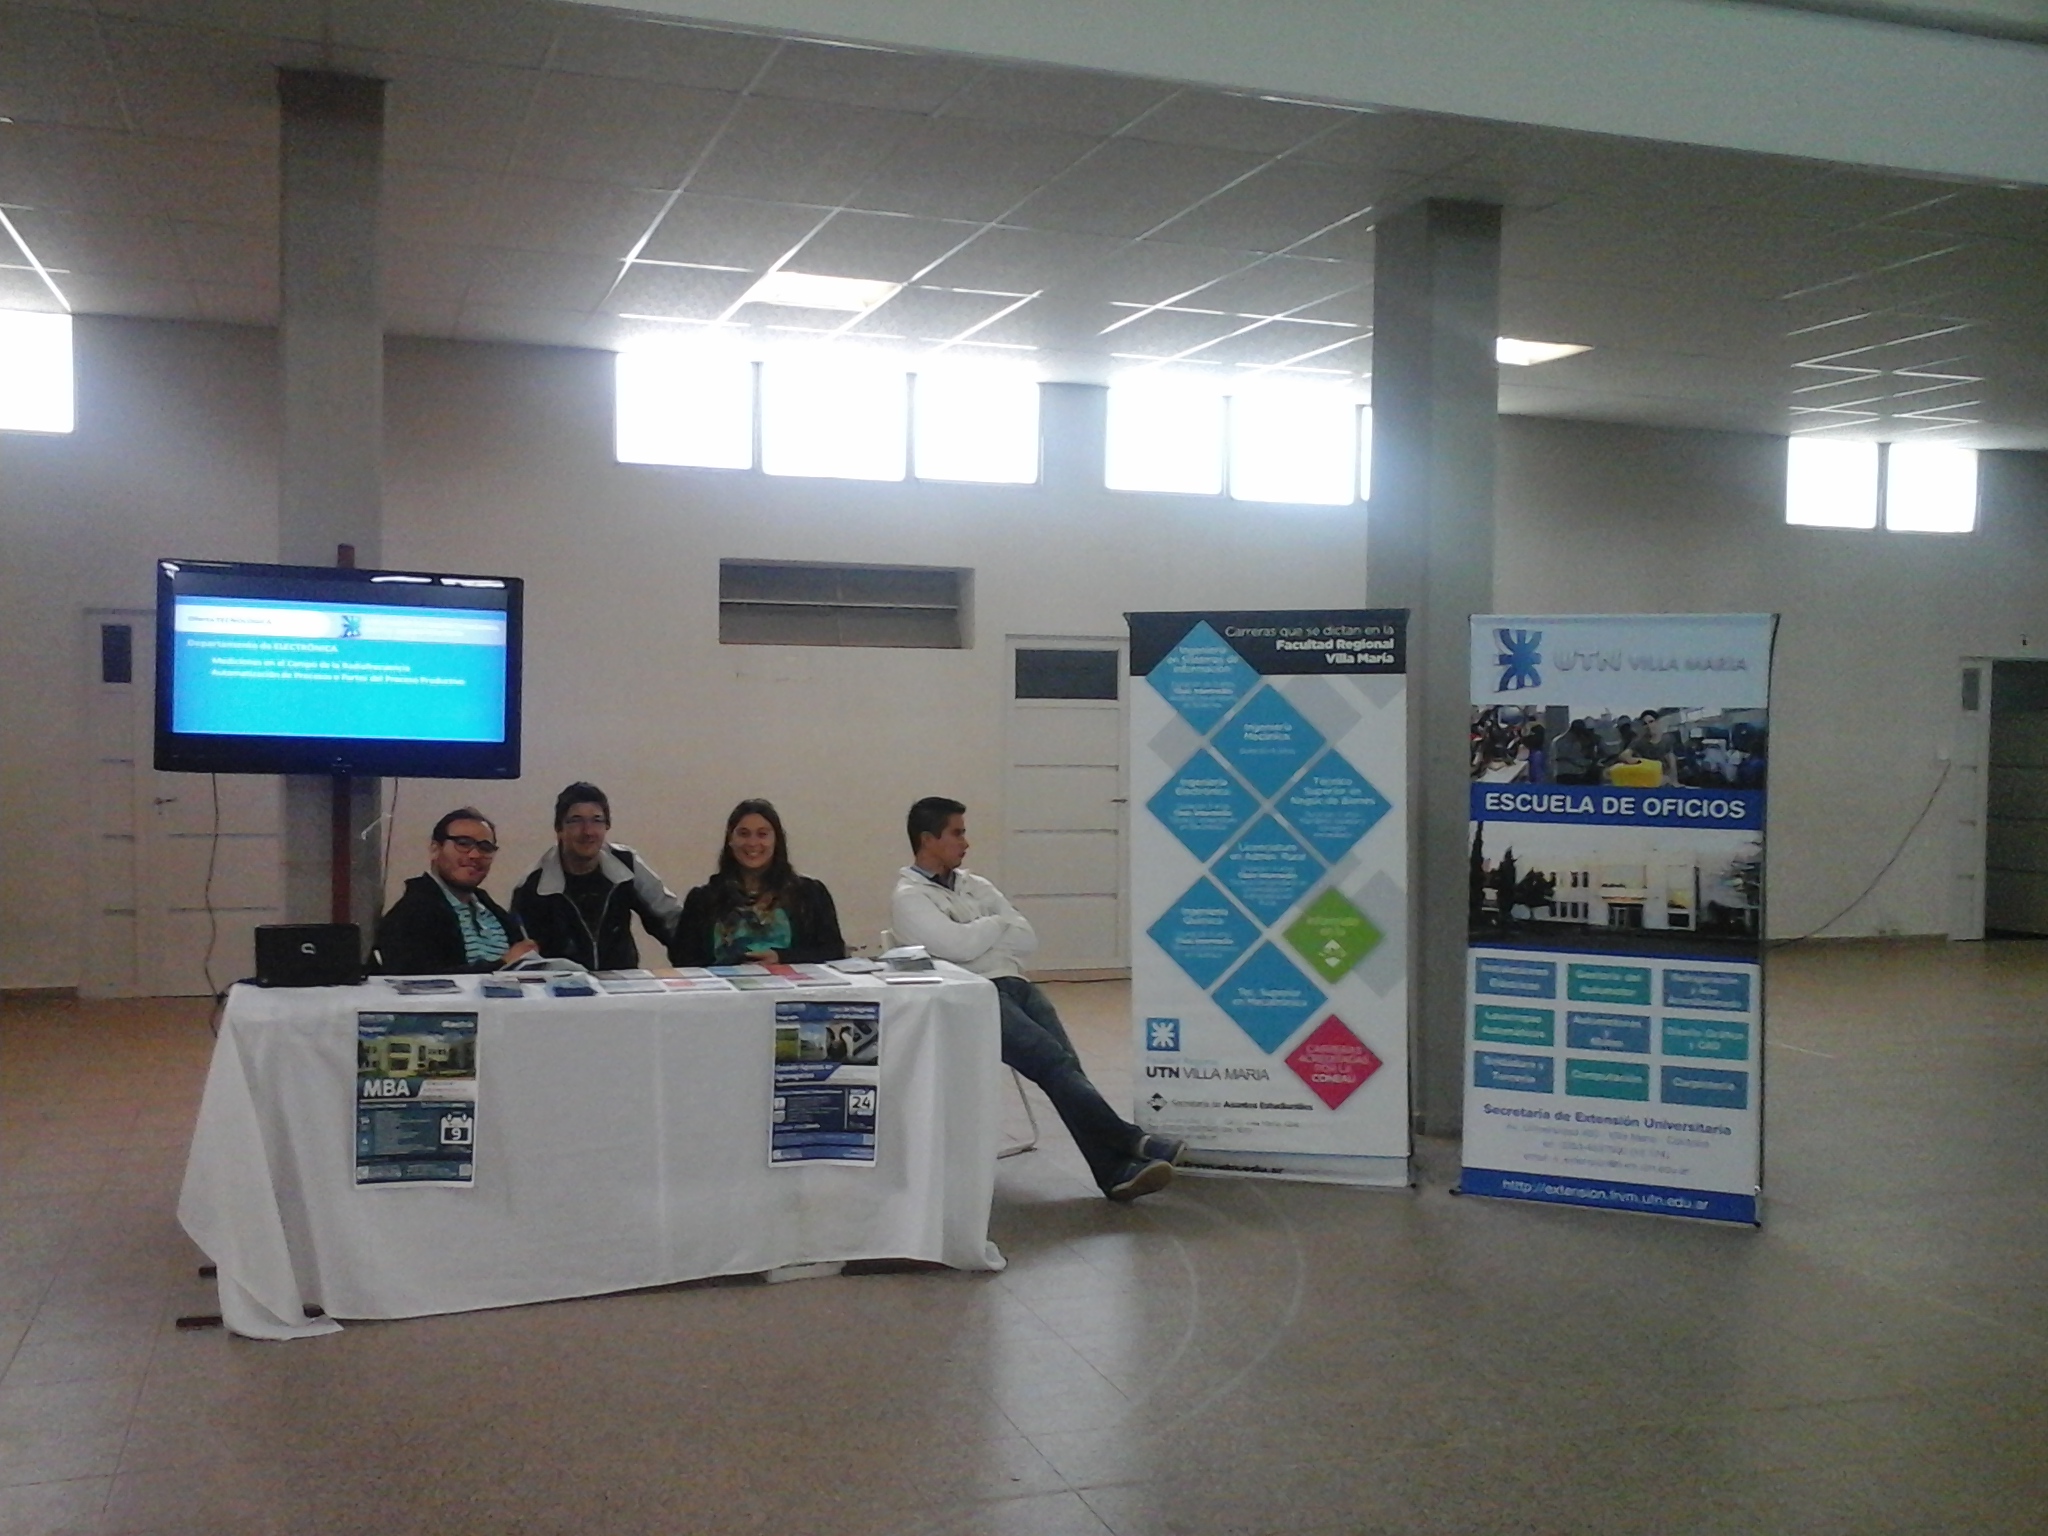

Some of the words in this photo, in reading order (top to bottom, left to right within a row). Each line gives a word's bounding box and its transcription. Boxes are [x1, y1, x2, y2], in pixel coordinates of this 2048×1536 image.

[1225, 626, 1276, 637] Carreras
[1280, 627, 1303, 639] que
[1305, 627, 1320, 637] se
[1323, 625, 1361, 636] dictan
[1364, 627, 1381, 636] en
[1383, 625, 1394, 635] la
[1276, 639, 1333, 650] Facultad
[1336, 639, 1394, 651] Regional
[1325, 653, 1354, 664] Villa
[1357, 652, 1394, 664] María
[1553, 650, 1622, 671] UTN
[1628, 654, 1679, 671] VILLA
[1485, 792, 1595, 815] ESCUELA
[1602, 796, 1635, 816] DE
[1642, 797, 1746, 819] OFICIOS
[1146, 1066, 1179, 1078] UTN
[1183, 1067, 1221, 1079] VILLA
[1224, 1067, 1270, 1081] MARIA
[363, 1079, 410, 1097] MBA
[852, 1096, 871, 1109] 24
[1554, 1110, 1571, 1122] de
[1644, 1117, 1732, 1136] Universitaria
[450, 1127, 462, 1141] 9
